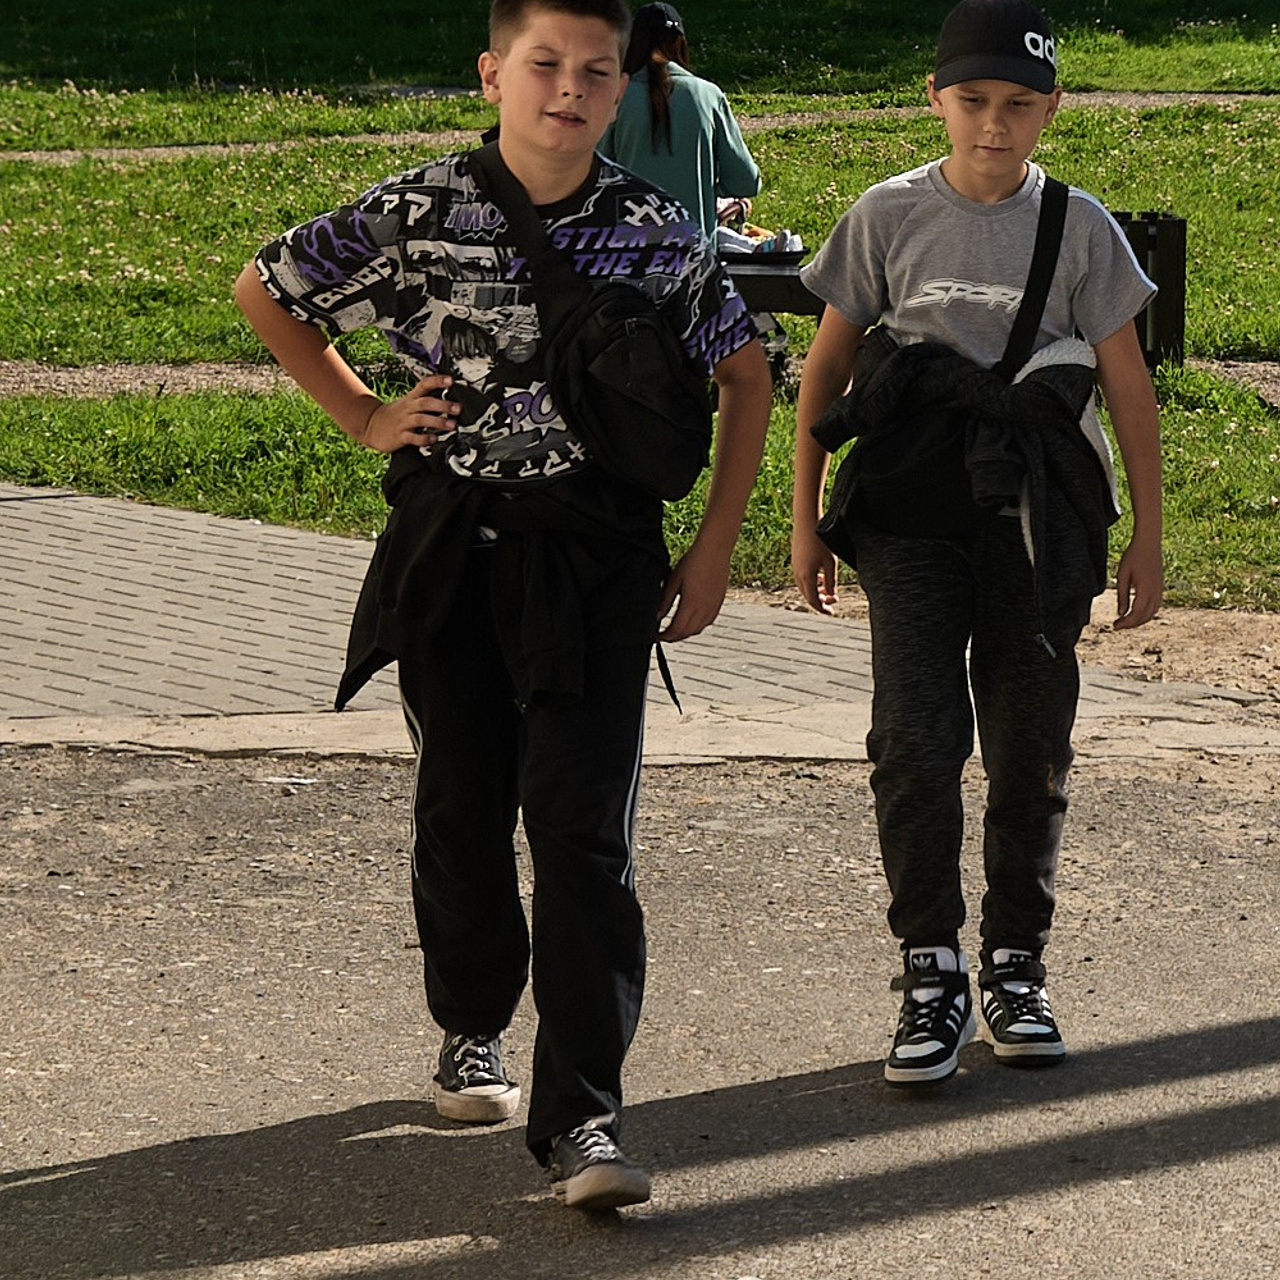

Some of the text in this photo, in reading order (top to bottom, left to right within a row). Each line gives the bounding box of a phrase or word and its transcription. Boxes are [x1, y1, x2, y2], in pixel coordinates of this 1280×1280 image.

[551, 226, 647, 251] STICK
[572, 250, 687, 276] THE EN
